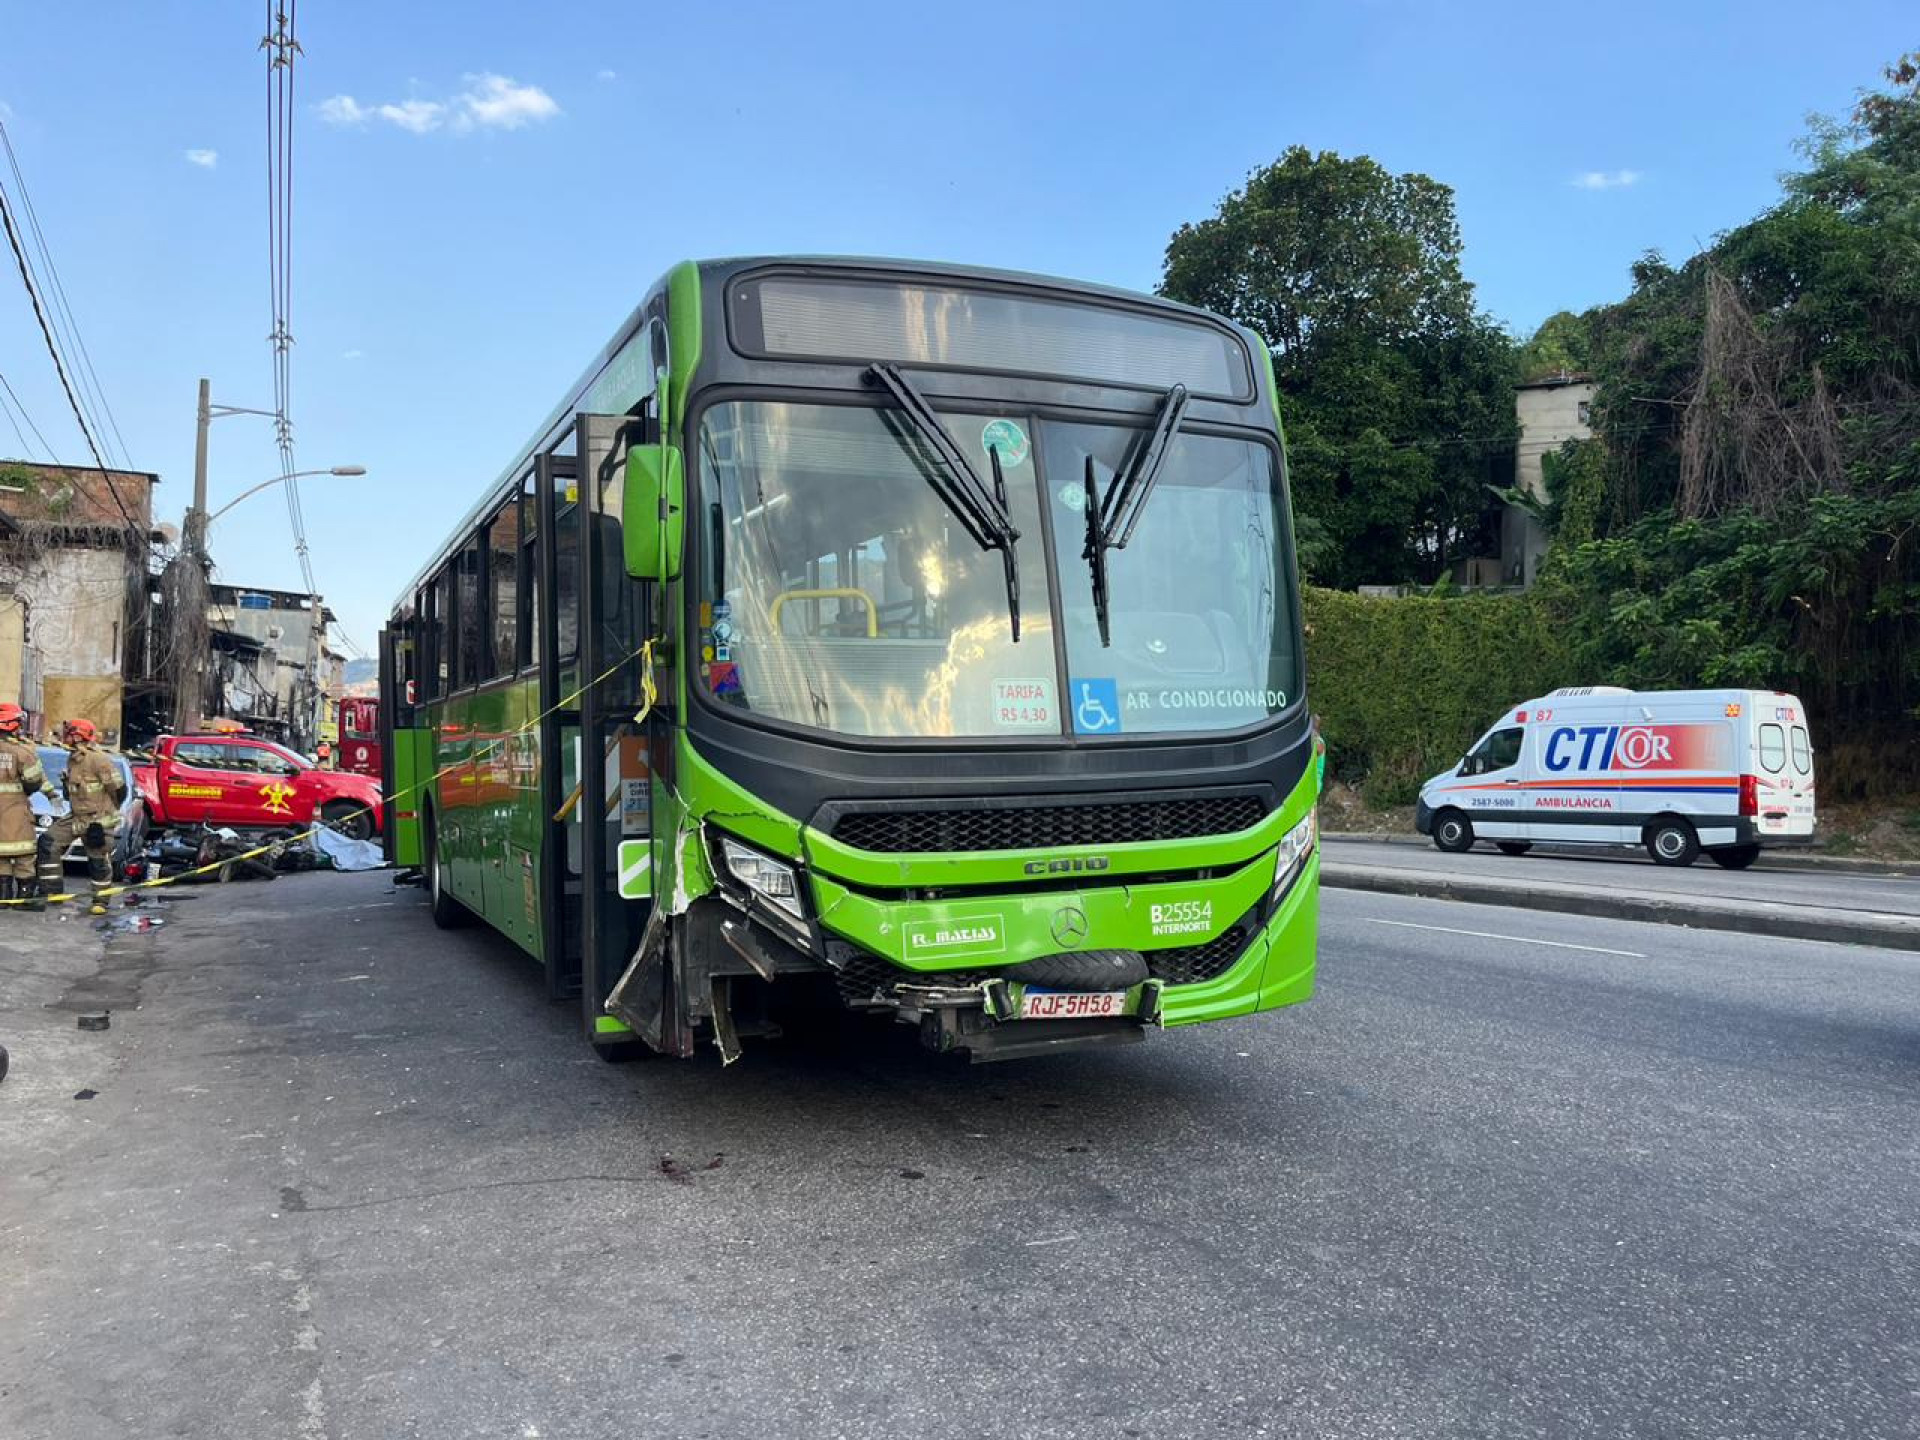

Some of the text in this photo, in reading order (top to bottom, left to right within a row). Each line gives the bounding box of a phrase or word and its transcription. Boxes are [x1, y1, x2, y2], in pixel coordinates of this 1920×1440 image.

[998, 684, 1043, 698] TARIFA
[1127, 690, 1287, 709] AR CONDICIONADO
[1536, 709, 1553, 721] 87
[1023, 856, 1109, 874] CAIO
[1152, 920, 1211, 936] INTERNORTE
[1031, 994, 1113, 1015] RJF5H58
